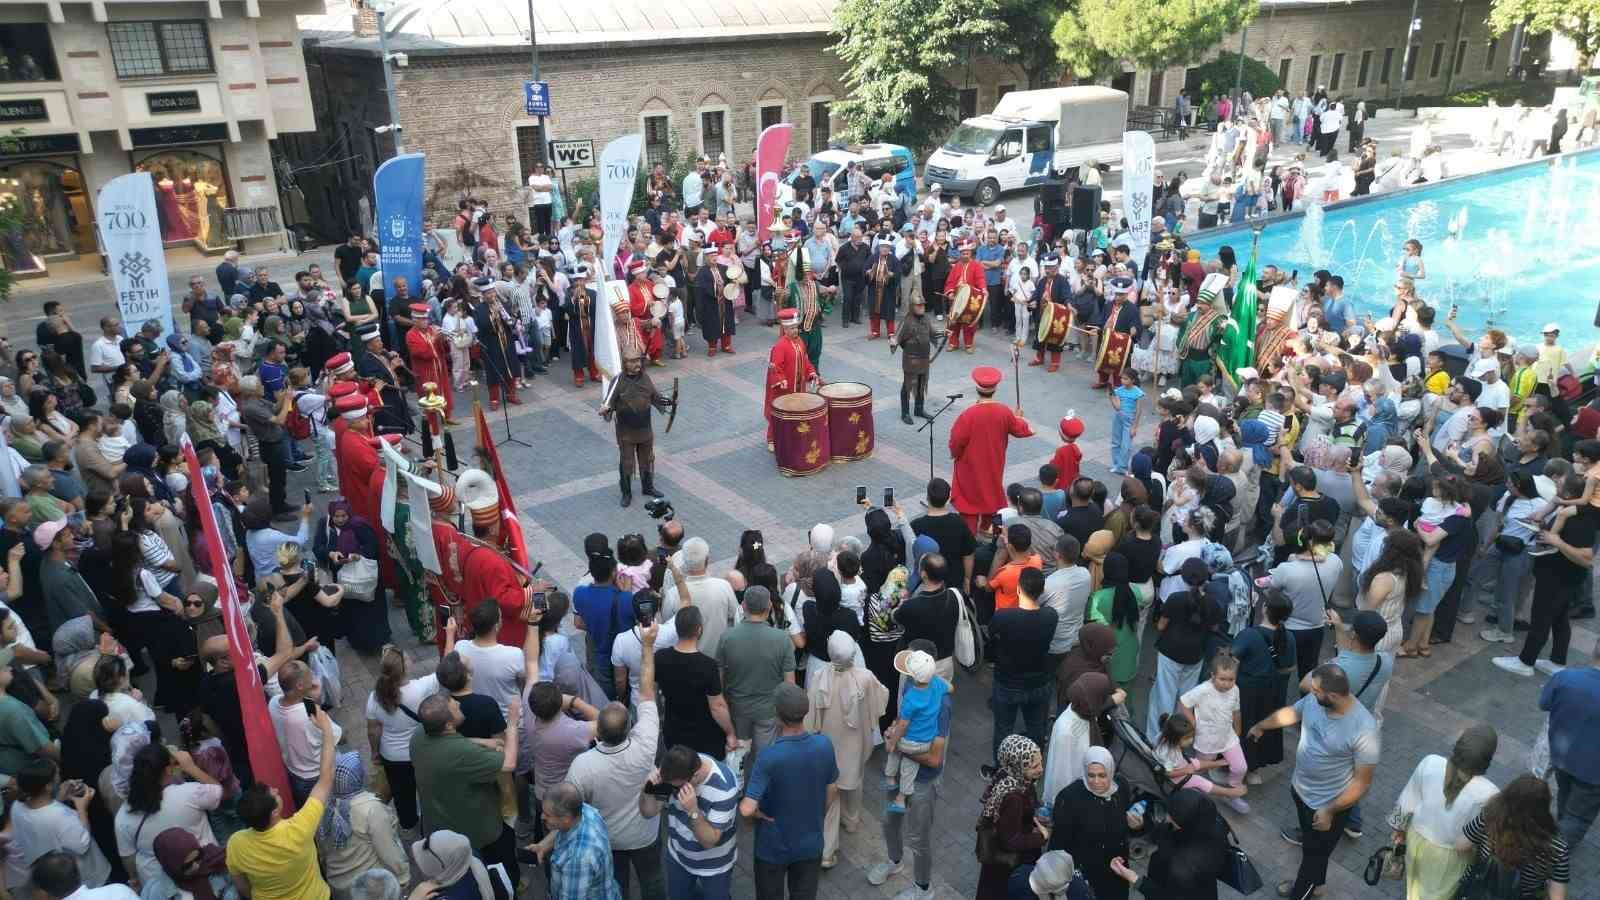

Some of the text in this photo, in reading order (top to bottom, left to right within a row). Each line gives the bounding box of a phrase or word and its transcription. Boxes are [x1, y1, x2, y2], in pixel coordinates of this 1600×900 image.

[557, 148, 589, 161] WC
[606, 164, 634, 180] 700
[104, 211, 146, 230] 700
[382, 245, 413, 253] BURSA
[122, 301, 150, 315] 700
